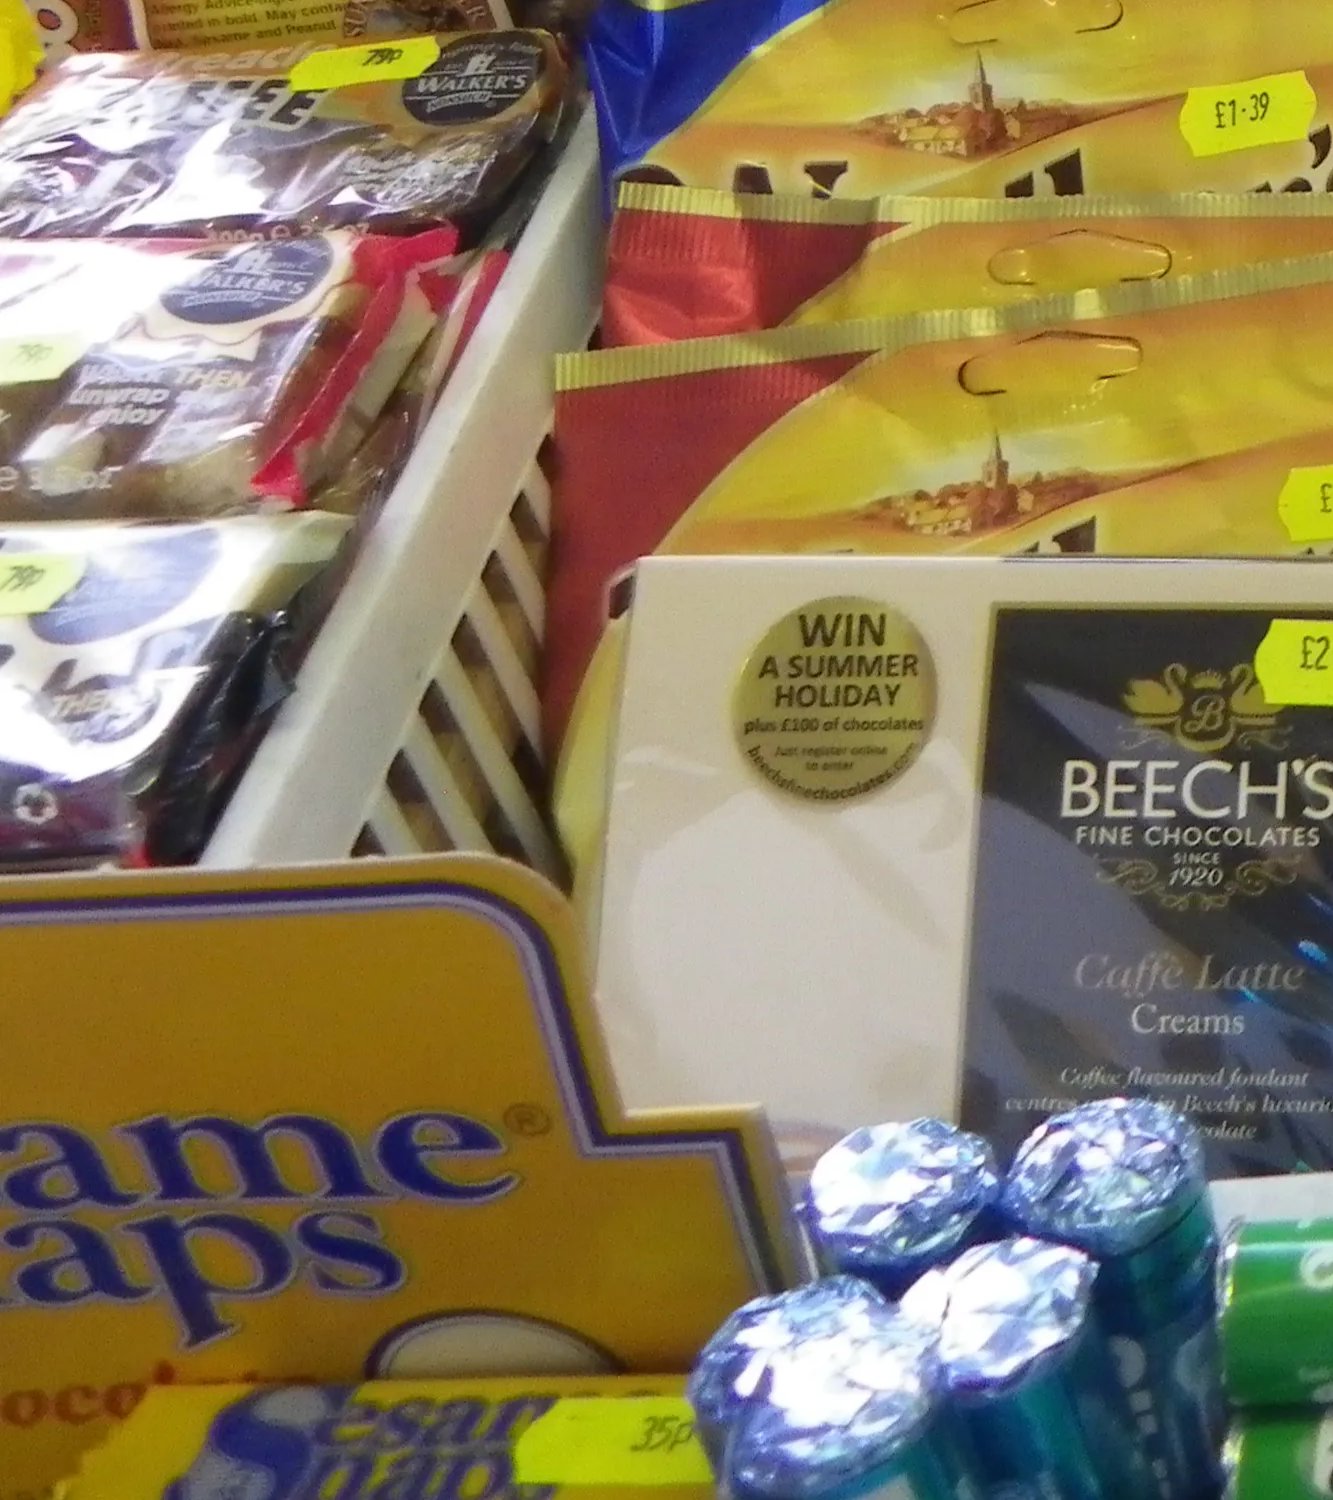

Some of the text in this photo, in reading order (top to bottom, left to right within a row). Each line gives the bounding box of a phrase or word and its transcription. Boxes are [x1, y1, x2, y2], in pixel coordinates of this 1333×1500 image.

[415, 72, 528, 96] WALKER'S
[797, 612, 887, 648] WIN
[757, 653, 920, 679] A SUMMER
[774, 683, 902, 709] HOLIDAY
[743, 717, 925, 736] plus £100 of chocolates
[1075, 825, 1322, 848] FINE CHOCOLATES
[1172, 851, 1221, 866] SINCE
[1167, 864, 1225, 889] 1920
[1195, 951, 1306, 992] Latte
[1130, 1004, 1246, 1036] Creams
[1060, 1065, 1310, 1091] Coffee flavoured fondant
